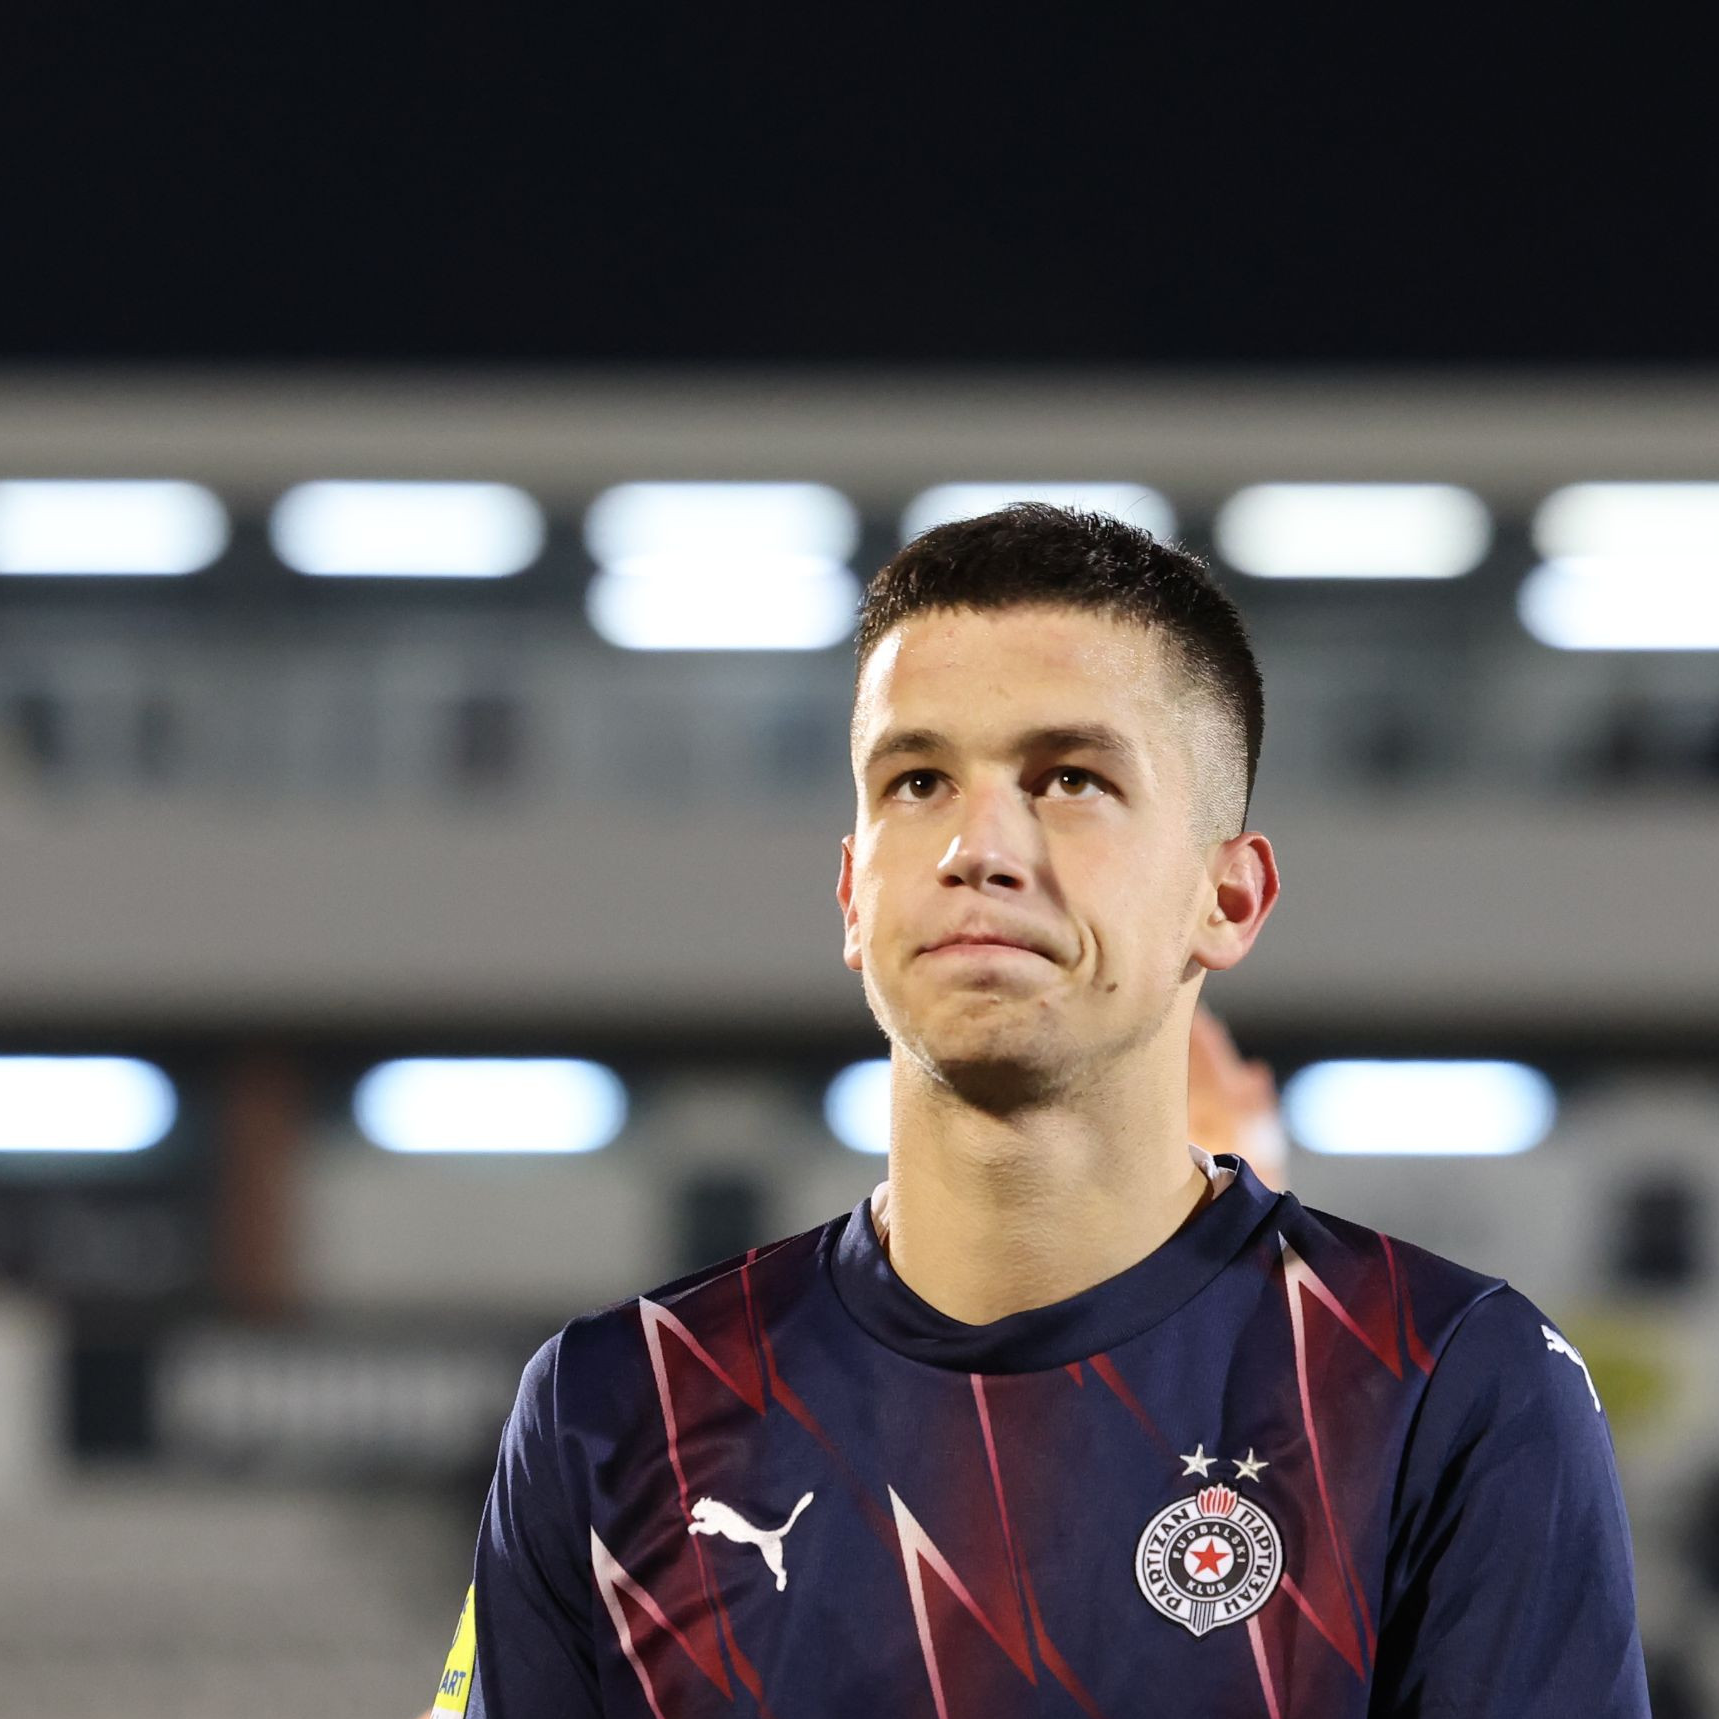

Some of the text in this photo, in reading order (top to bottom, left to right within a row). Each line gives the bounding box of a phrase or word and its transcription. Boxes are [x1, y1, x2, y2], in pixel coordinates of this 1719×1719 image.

[1146, 1507, 1191, 1612] PARTIZAN
[1172, 1524, 1246, 1563] FUDBALSKI
[1185, 1579, 1227, 1596] KLUB
